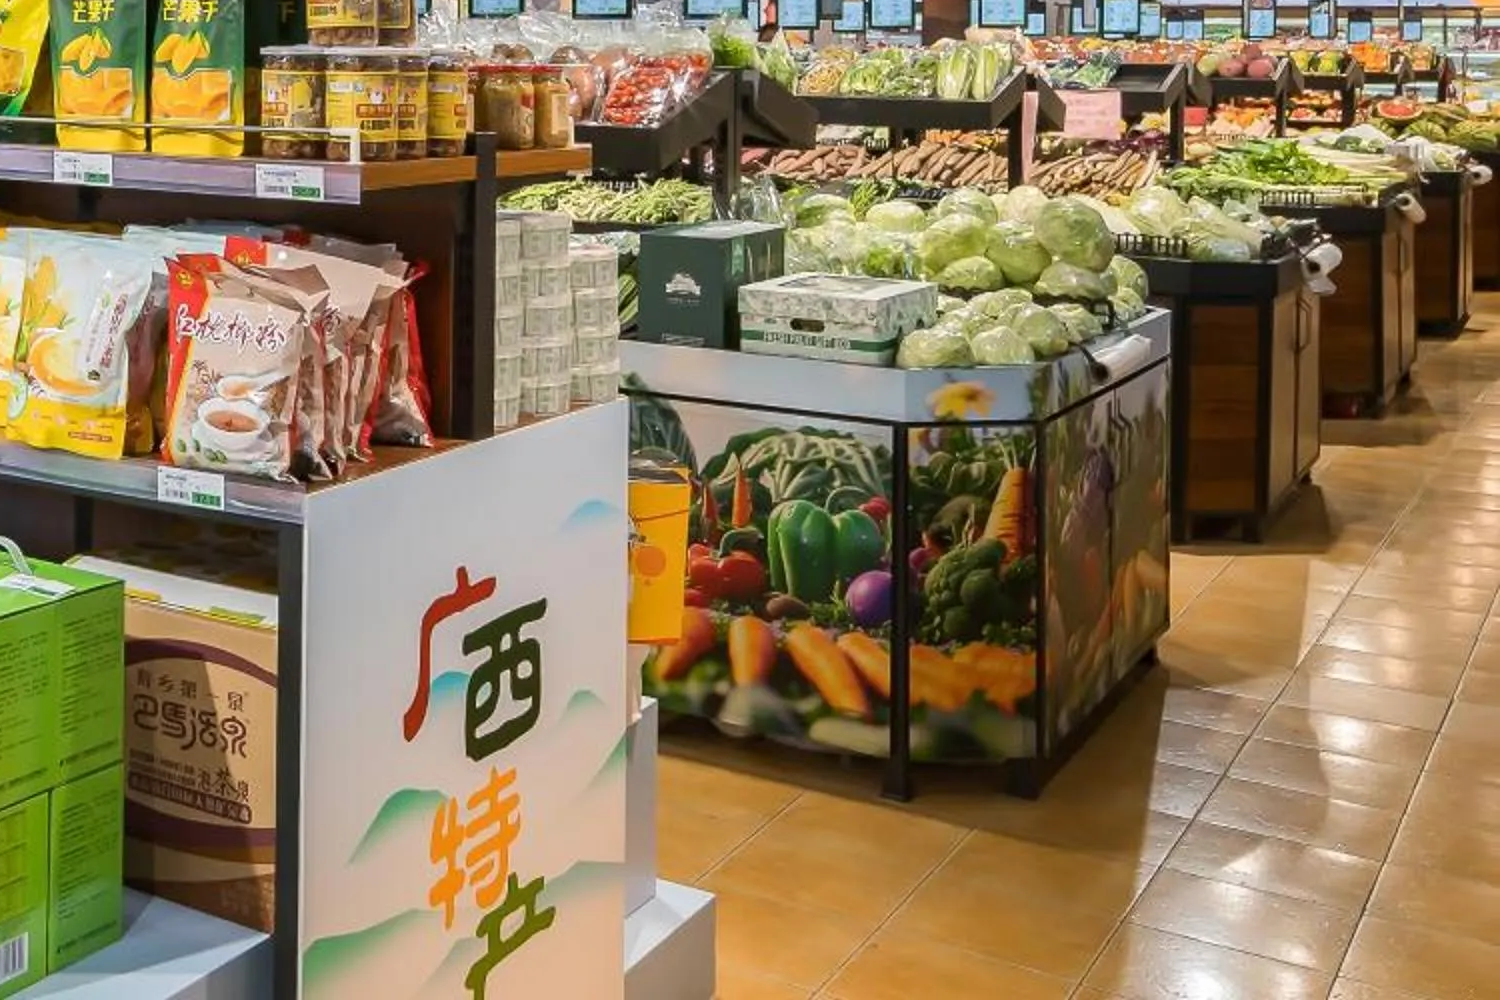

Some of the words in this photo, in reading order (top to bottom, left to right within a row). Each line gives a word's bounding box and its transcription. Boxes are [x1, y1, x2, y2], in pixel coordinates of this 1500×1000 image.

[72, 0, 116, 24] 芒果干
[403, 565, 557, 1000] 广西特产
